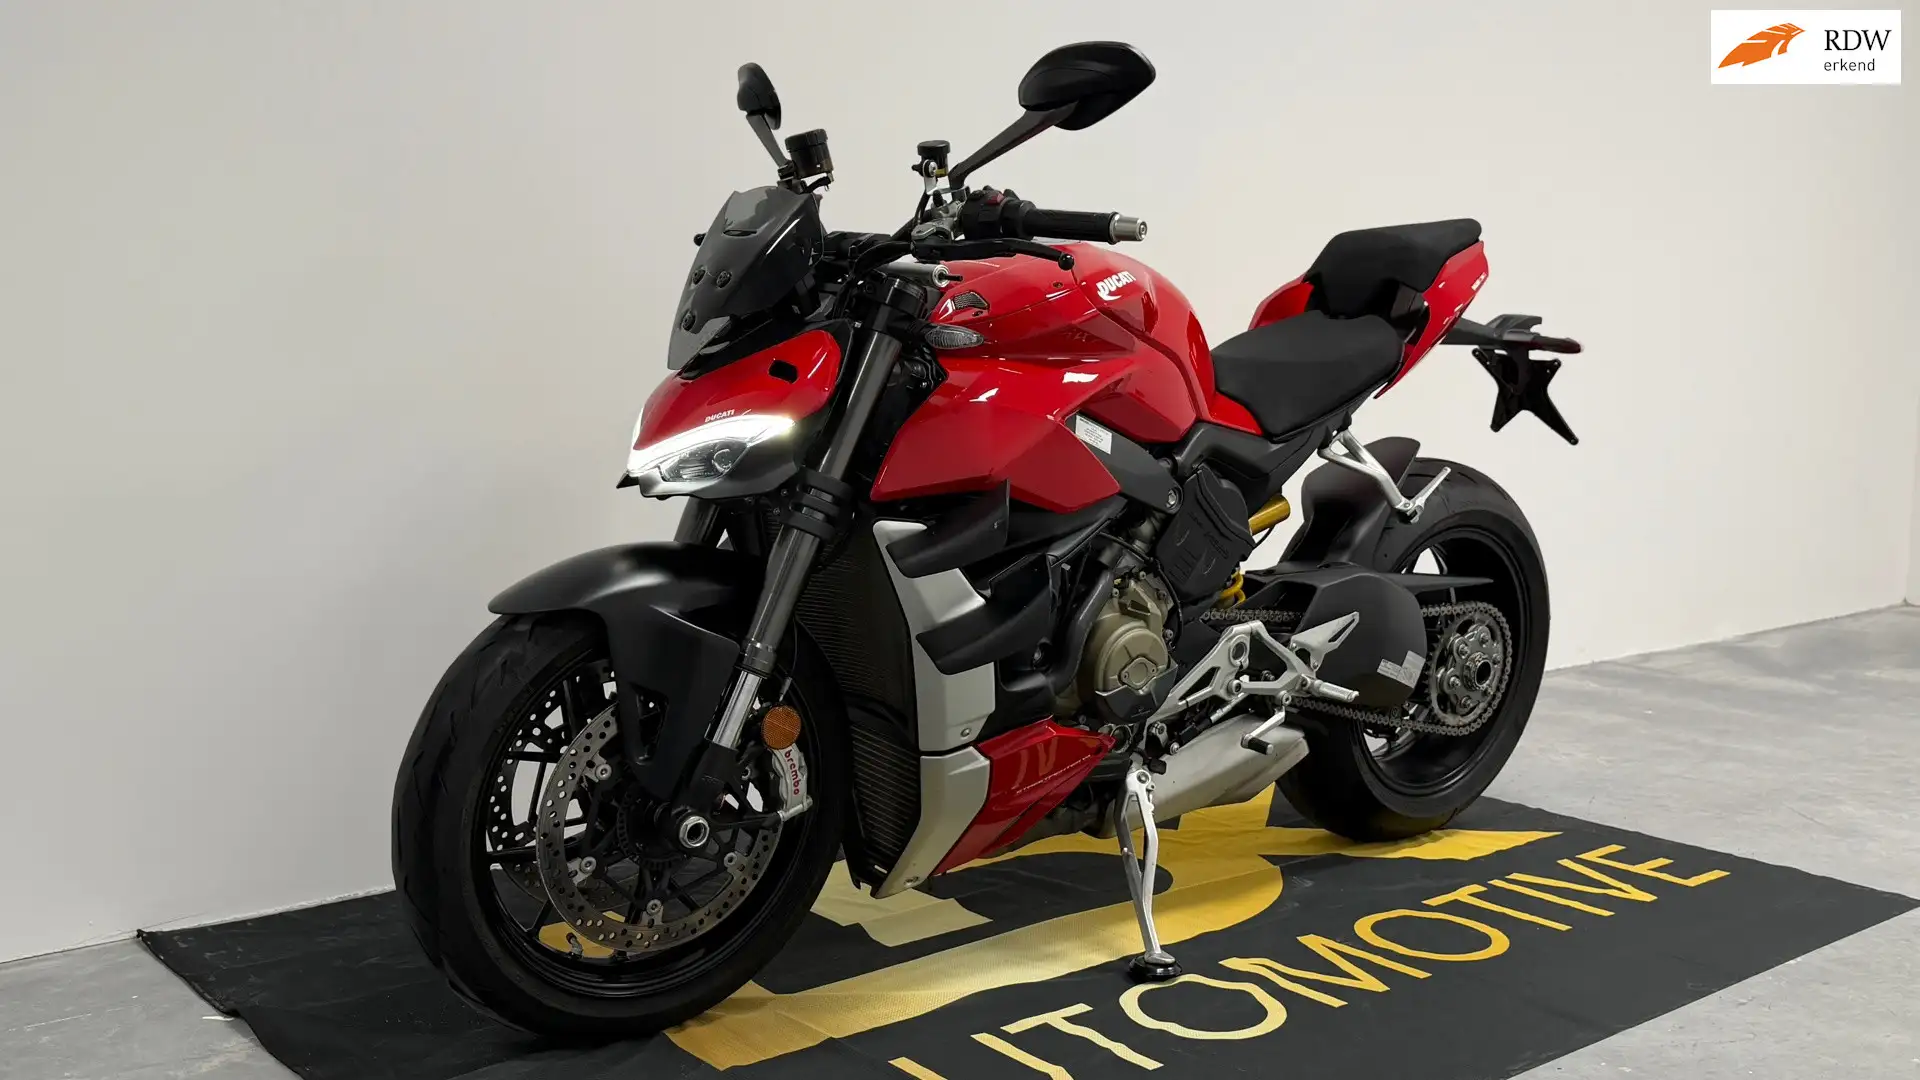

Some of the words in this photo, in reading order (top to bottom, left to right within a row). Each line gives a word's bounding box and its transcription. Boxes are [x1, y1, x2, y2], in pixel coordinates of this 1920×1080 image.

[1095, 270, 1137, 301] DUCATI
[704, 408, 736, 423] DUCATI
[784, 749, 800, 796] brembo
